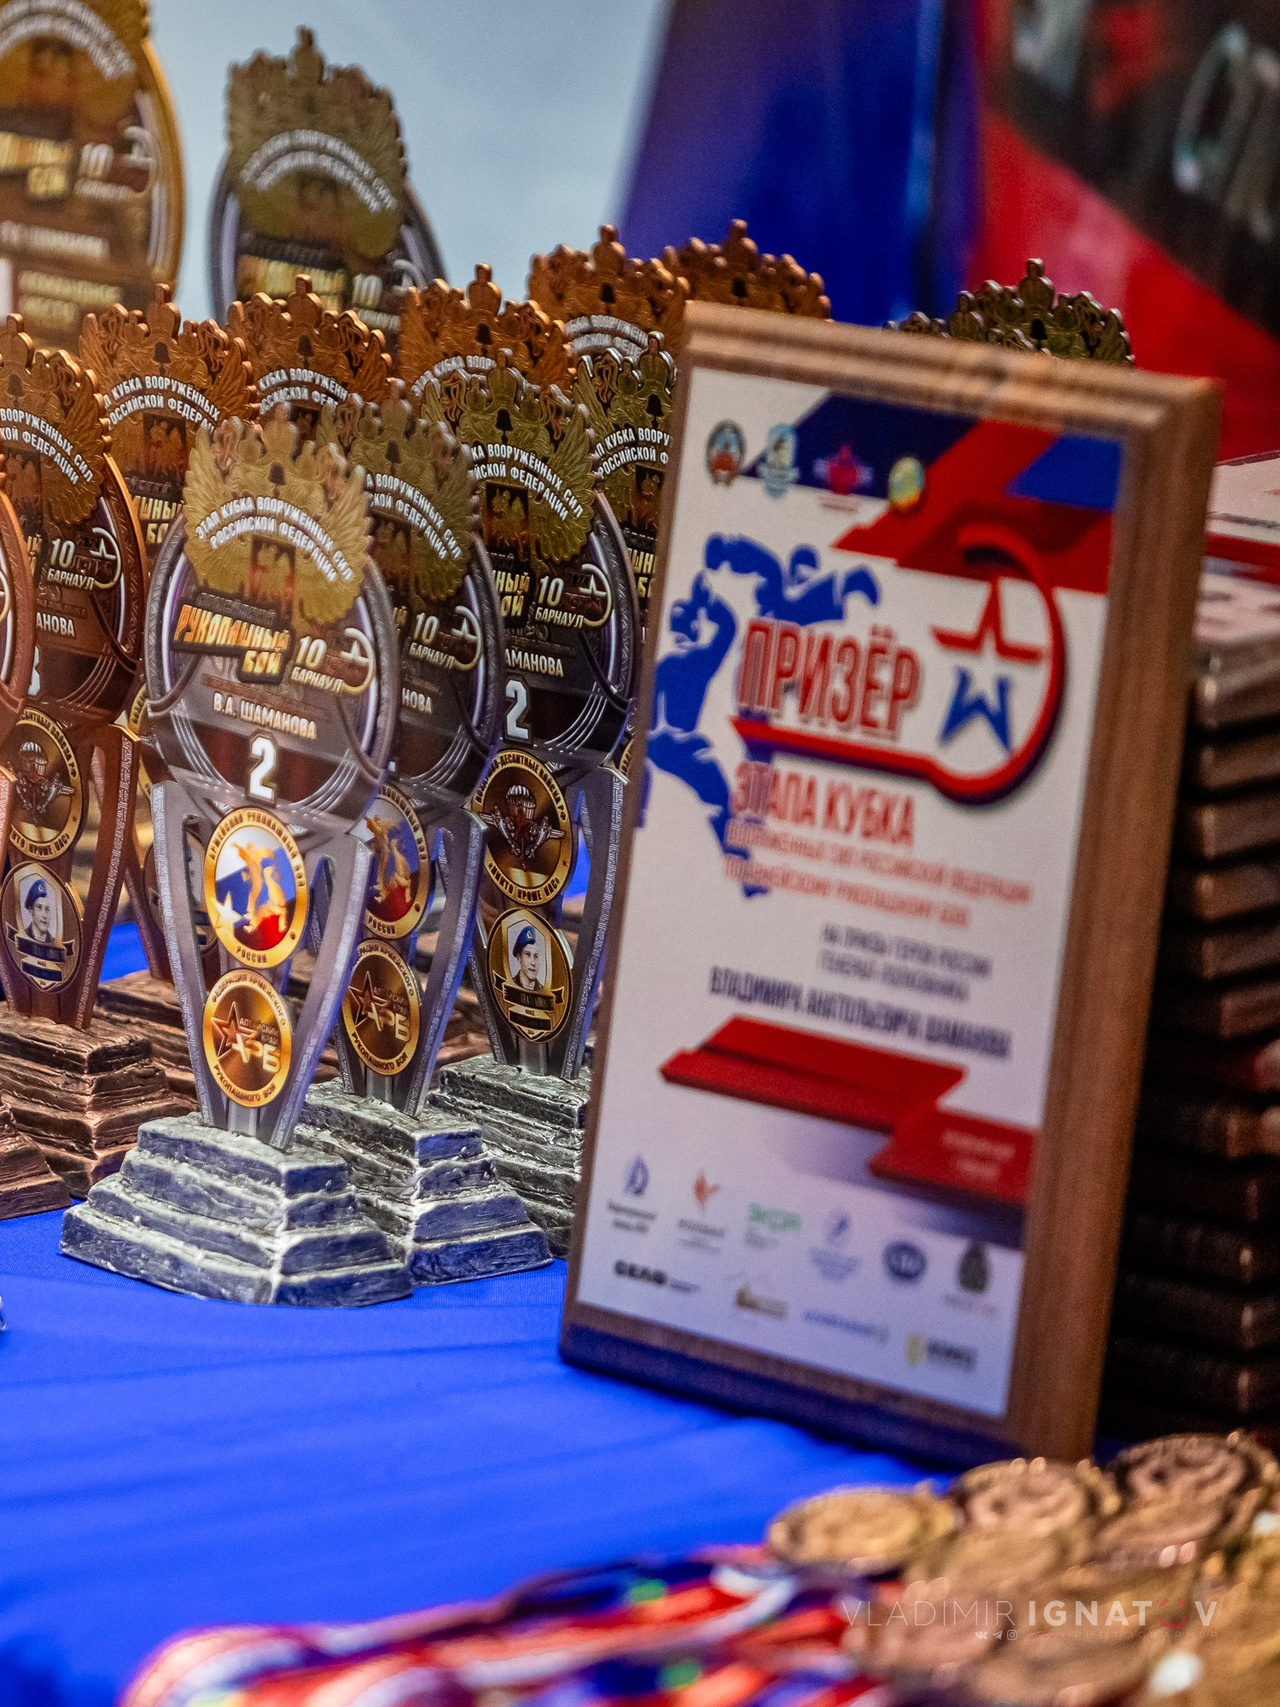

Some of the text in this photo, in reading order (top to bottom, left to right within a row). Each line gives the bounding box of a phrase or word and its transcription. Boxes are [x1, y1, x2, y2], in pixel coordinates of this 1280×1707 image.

[112, 375, 220, 421] КУБКА ВООРУЖЁННЫХ
[257, 369, 288, 391] КУБКА
[0, 408, 73, 456] ВООРУЖЁННЫХ
[73, 457, 95, 483] СИЛ
[22, 426, 79, 485] ФЕДЕРАЦИИ
[604, 428, 635, 452] КУБКА
[488, 443, 584, 518] ВООРУЖЁННЫХ СИЛ
[599, 448, 656, 477] РОССИЙСКОЙ
[510, 467, 569, 521] ФЕДЕРАЦИИ
[376, 473, 463, 559] ВООРУЖЁННЫХ СИЛ
[395, 500, 448, 561] ФЕДЕРАЦИИ
[50, 538, 75, 568] 10
[195, 511, 220, 541] ЭТАП
[220, 497, 254, 518] КУБКА
[332, 548, 354, 582] СИЛ
[209, 516, 339, 584] РОССИЙСКОЙ ФЕДЕРАЦИИ
[47, 568, 95, 591] БАРНАУЛ
[538, 576, 564, 606] 10
[174, 604, 290, 650] РУКОПАШНЫЙ
[414, 612, 439, 644] 10
[535, 607, 584, 629] БАРНАУЛ
[242, 647, 281, 675] БОЙ
[295, 636, 327, 668] 10
[409, 642, 455, 669] БАРНАУЛ
[291, 666, 343, 693] БАРНАУЛ
[738, 618, 921, 741] ПРИЗЁР
[213, 692, 317, 739] В.А. ШАМАНОВА
[505, 679, 530, 739] 2
[249, 735, 277, 800] 2
[823, 778, 914, 848] КУБКА
[517, 888, 542, 902] КРОМЕ
[368, 915, 396, 935] РОССИИ
[214, 1063, 261, 1102] РУКОПАШНОГО
